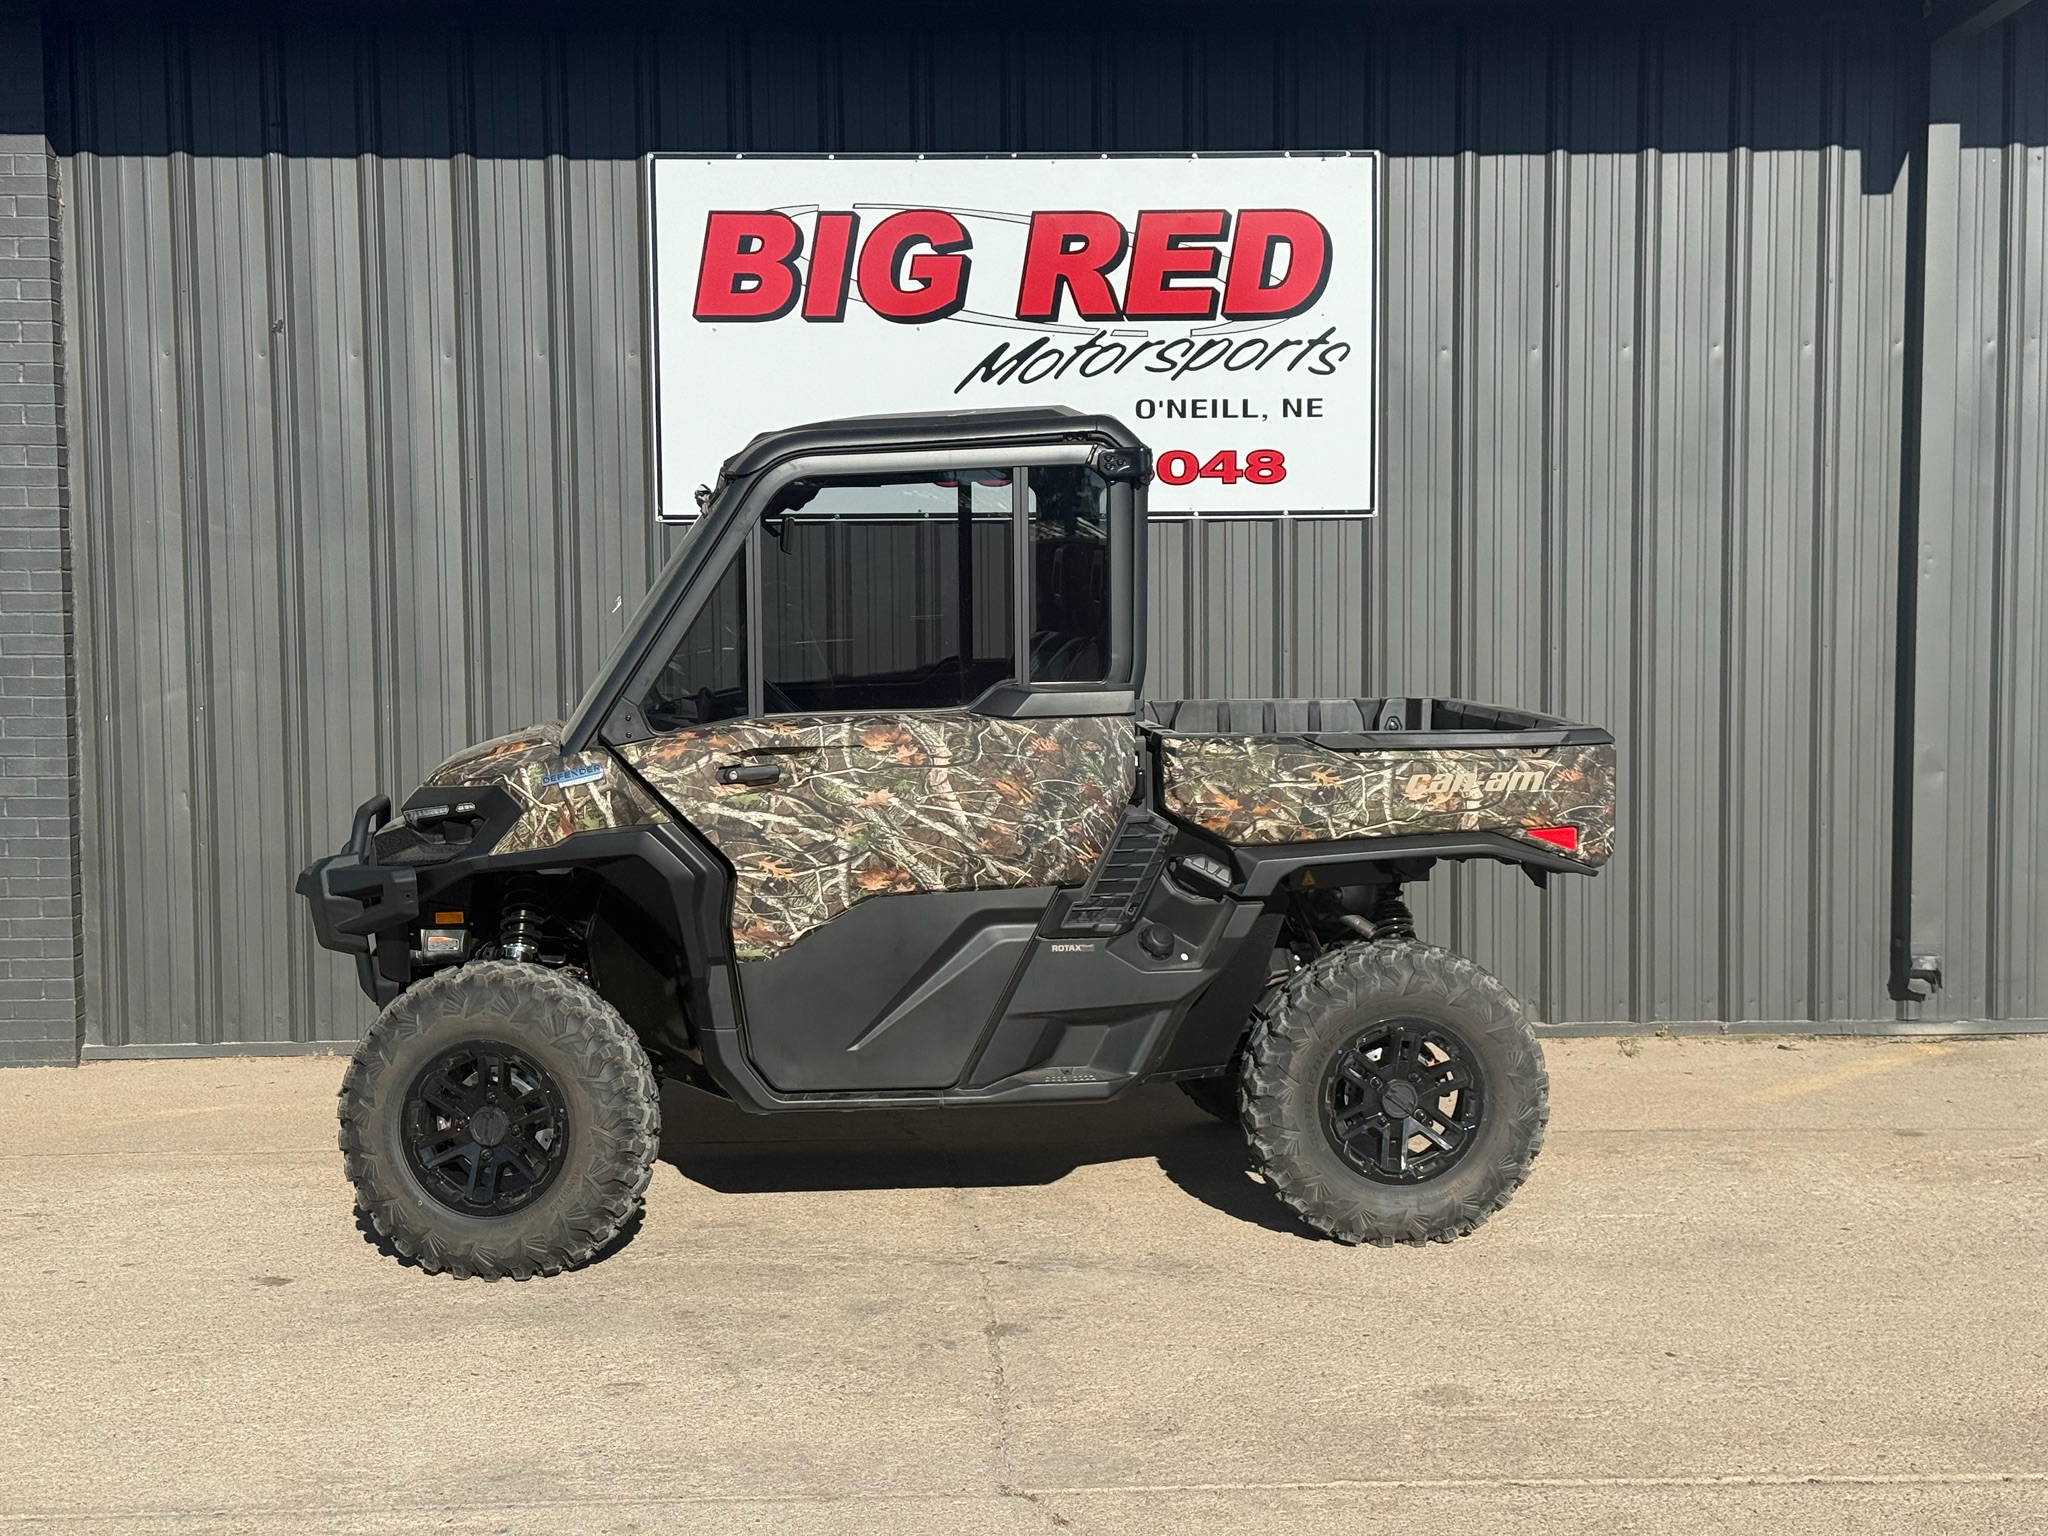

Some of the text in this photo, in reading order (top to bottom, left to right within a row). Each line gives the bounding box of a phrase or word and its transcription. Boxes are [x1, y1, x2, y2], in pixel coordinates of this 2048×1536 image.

[693, 208, 1334, 325] BIG RED
[954, 326, 1351, 394] Motorsports
[1135, 398, 1324, 421] O'NEILL, NE
[1151, 449, 1287, 485] 048
[542, 764, 601, 784] DEFENDER
[1051, 944, 1082, 953] ROTAX
